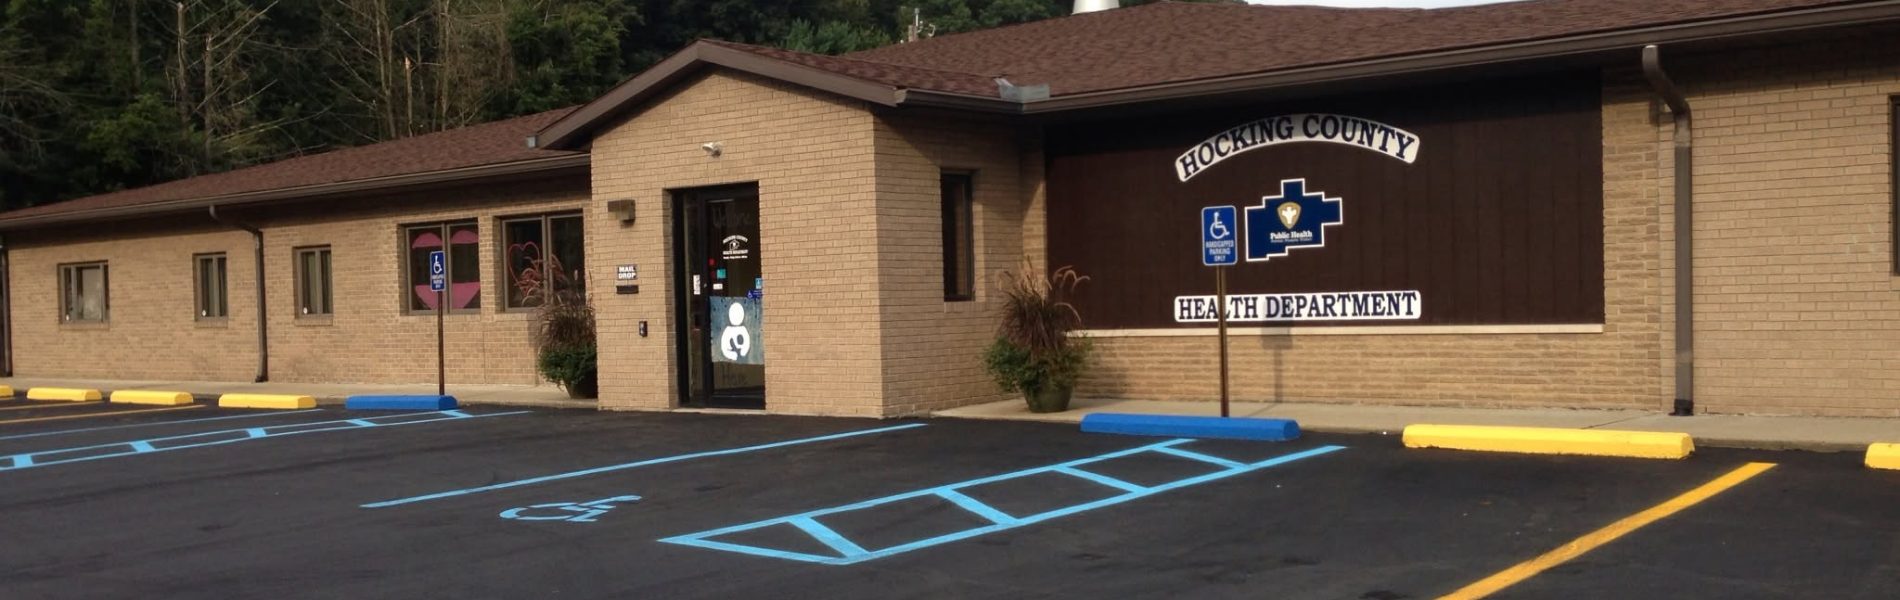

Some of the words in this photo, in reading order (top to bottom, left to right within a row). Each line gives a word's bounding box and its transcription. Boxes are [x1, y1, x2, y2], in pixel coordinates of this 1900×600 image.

[1180, 116, 1294, 179] HOCKING
[1303, 115, 1415, 159] COUNTY
[1265, 291, 1416, 318] DEPARTMENT
